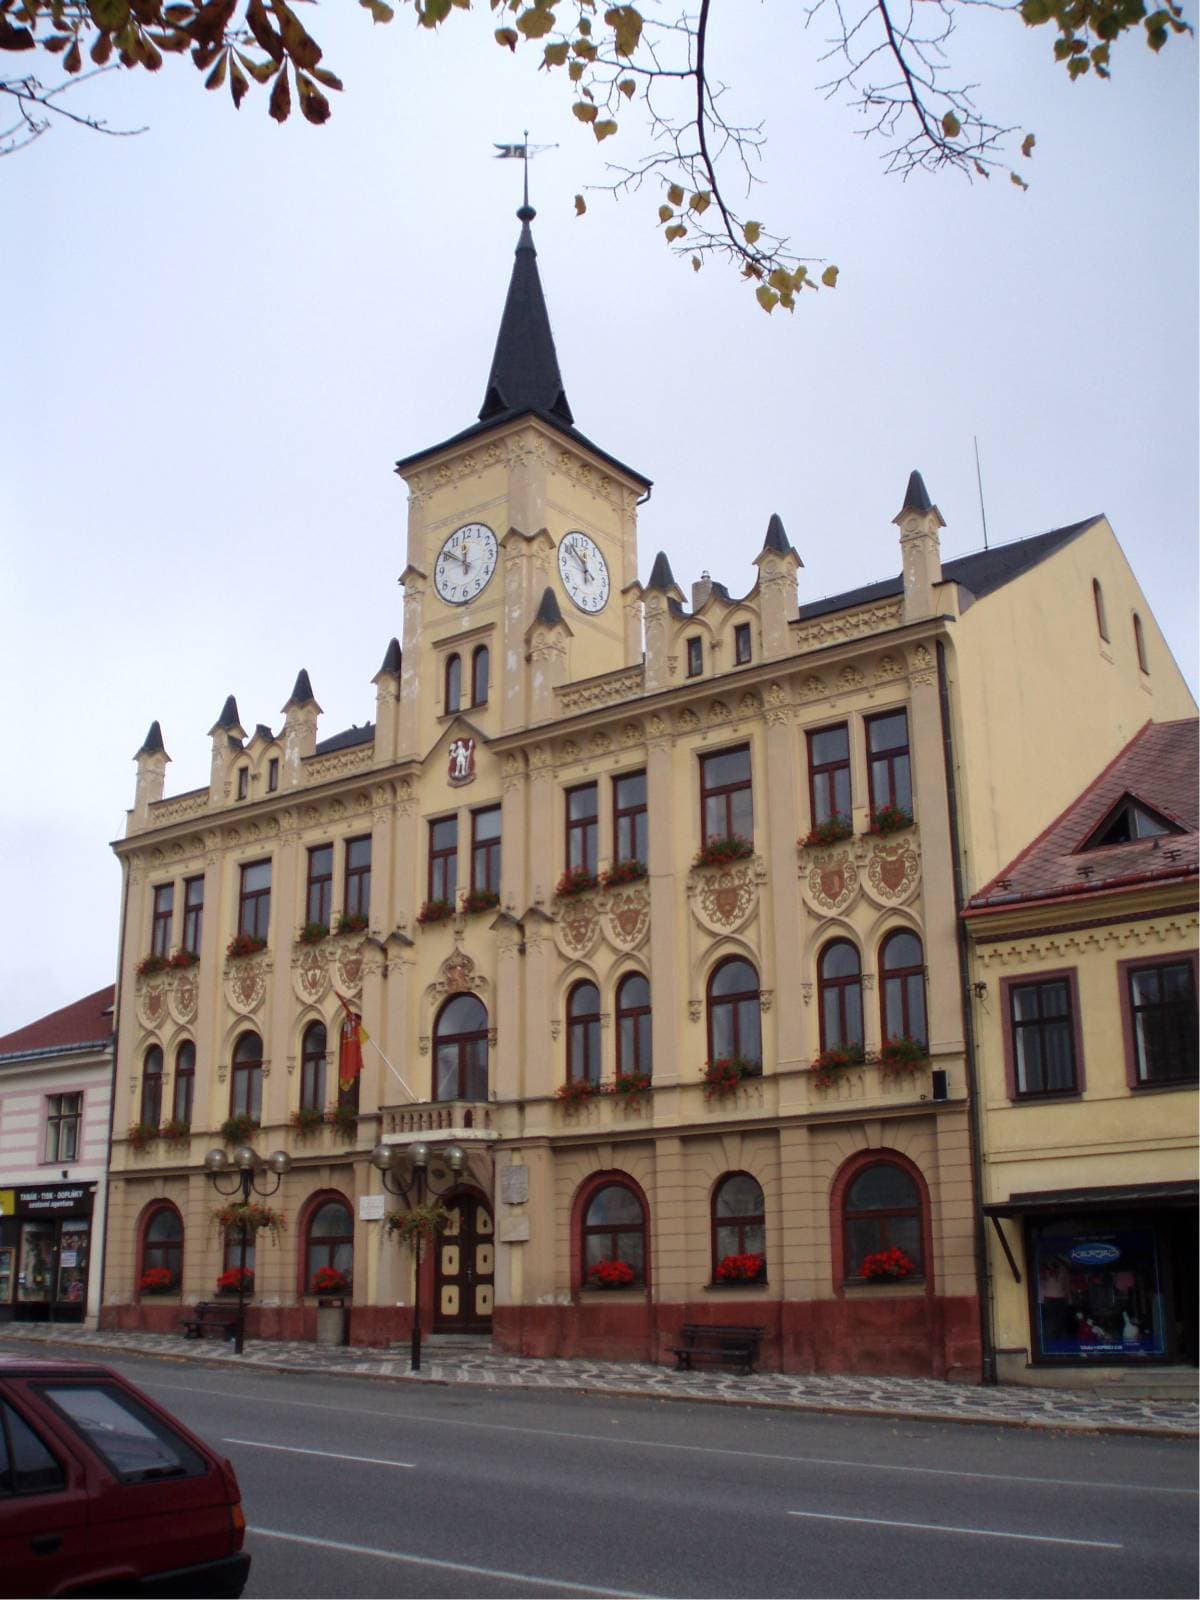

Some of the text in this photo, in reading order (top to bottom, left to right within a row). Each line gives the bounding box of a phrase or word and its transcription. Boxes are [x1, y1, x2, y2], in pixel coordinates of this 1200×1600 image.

[463, 528, 472, 540] 12
[452, 537, 460, 548] 11
[485, 536, 490, 546] 2
[439, 567, 445, 578] 9
[451, 586, 457, 598] 7
[462, 586, 468, 598] 6
